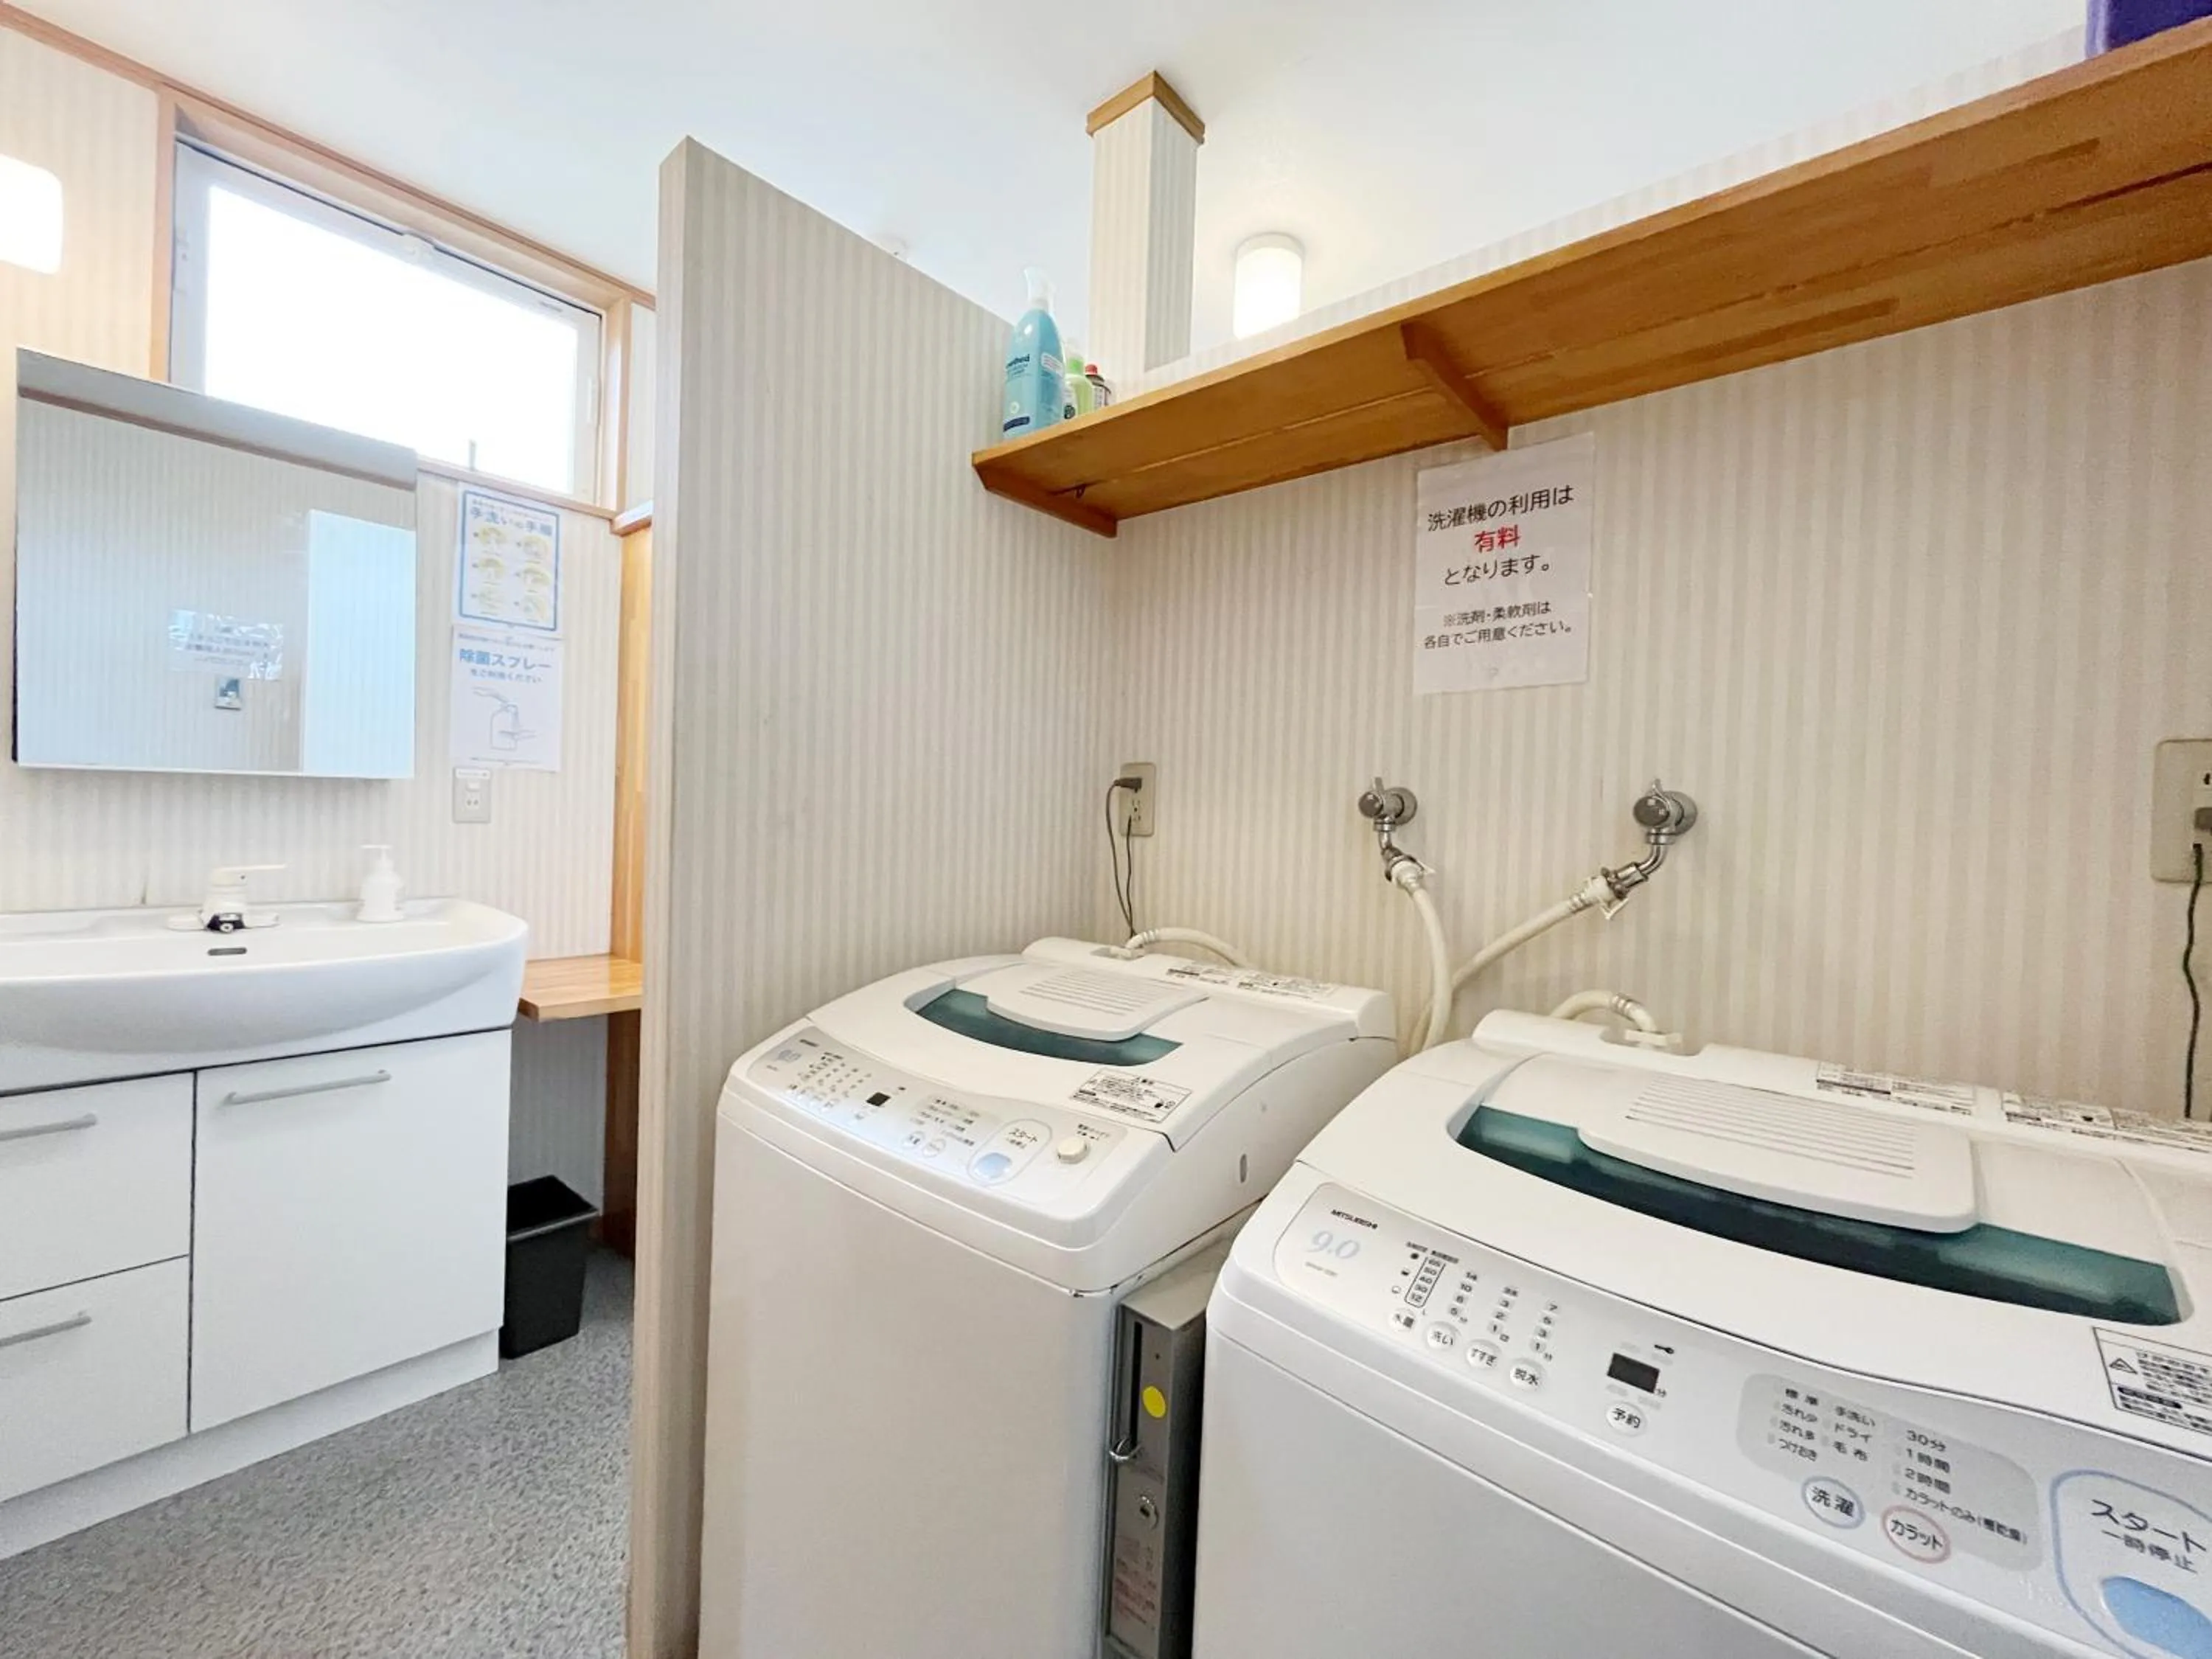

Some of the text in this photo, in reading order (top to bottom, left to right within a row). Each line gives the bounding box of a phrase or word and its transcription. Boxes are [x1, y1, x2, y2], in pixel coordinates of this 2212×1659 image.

[1427, 484, 1575, 532] 洗濯機の利用は
[1475, 524, 1520, 553] 有料
[1444, 554, 1550, 586] となります。
[1424, 620, 1572, 650] 各自でご用意ください。
[459, 648, 552, 669] 除菌スプレー
[1306, 1231, 1361, 1260] 9.0
[1613, 1407, 1641, 1429] 予約
[1834, 1422, 1873, 1444] ドライ
[1907, 1429, 1947, 1453] 30分
[1906, 1447, 1950, 1473] 1時間
[1905, 1467, 1950, 1495] 2時間
[1811, 1485, 1855, 1518] 洗濯
[1891, 1517, 1944, 1551] カラット
[2091, 1499, 2207, 1553] スタート
